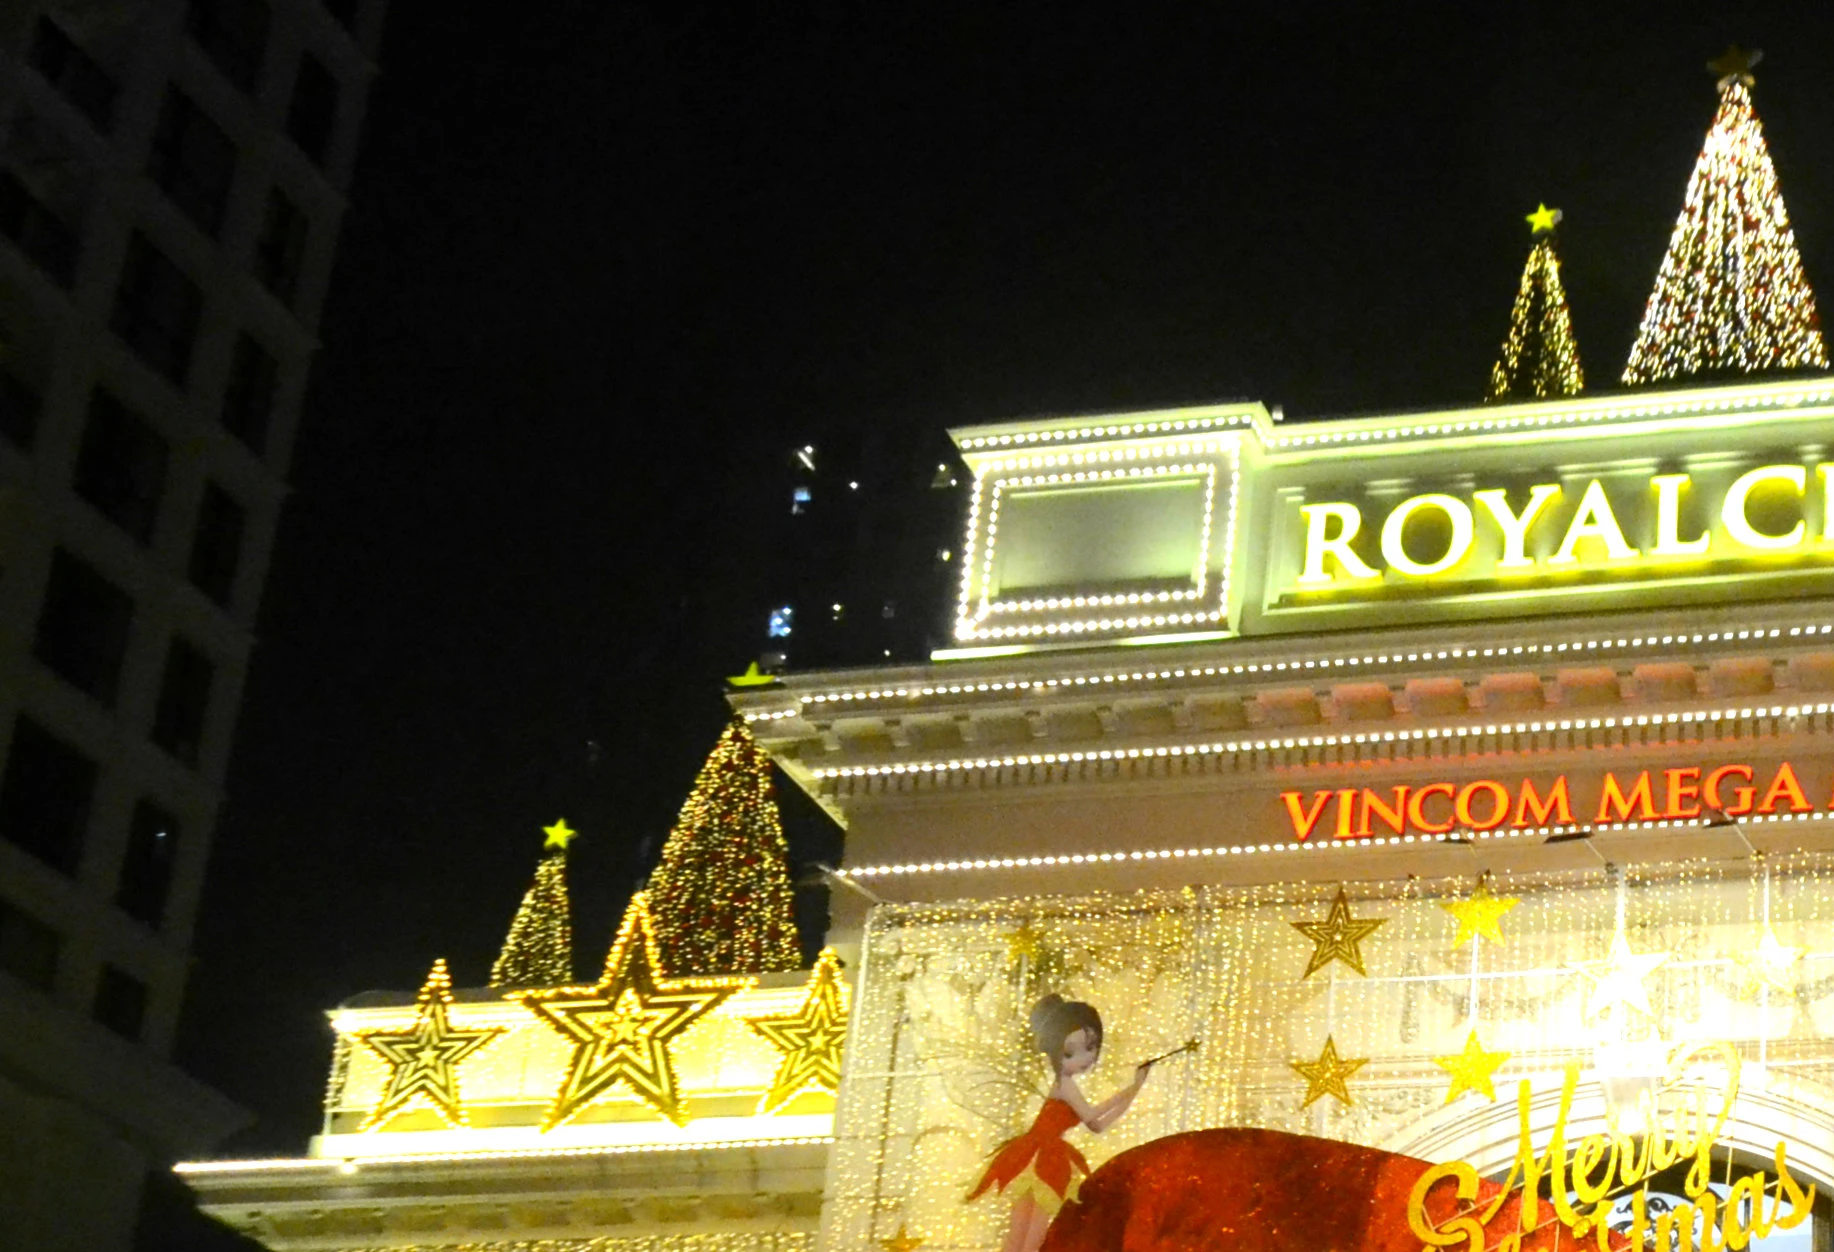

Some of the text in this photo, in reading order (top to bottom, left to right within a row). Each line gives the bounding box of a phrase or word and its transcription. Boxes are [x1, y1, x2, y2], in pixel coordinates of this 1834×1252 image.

[1280, 774, 1577, 840] VINCOM
[1593, 760, 1813, 825] MEGA
[1407, 1040, 1743, 1247] Merry
